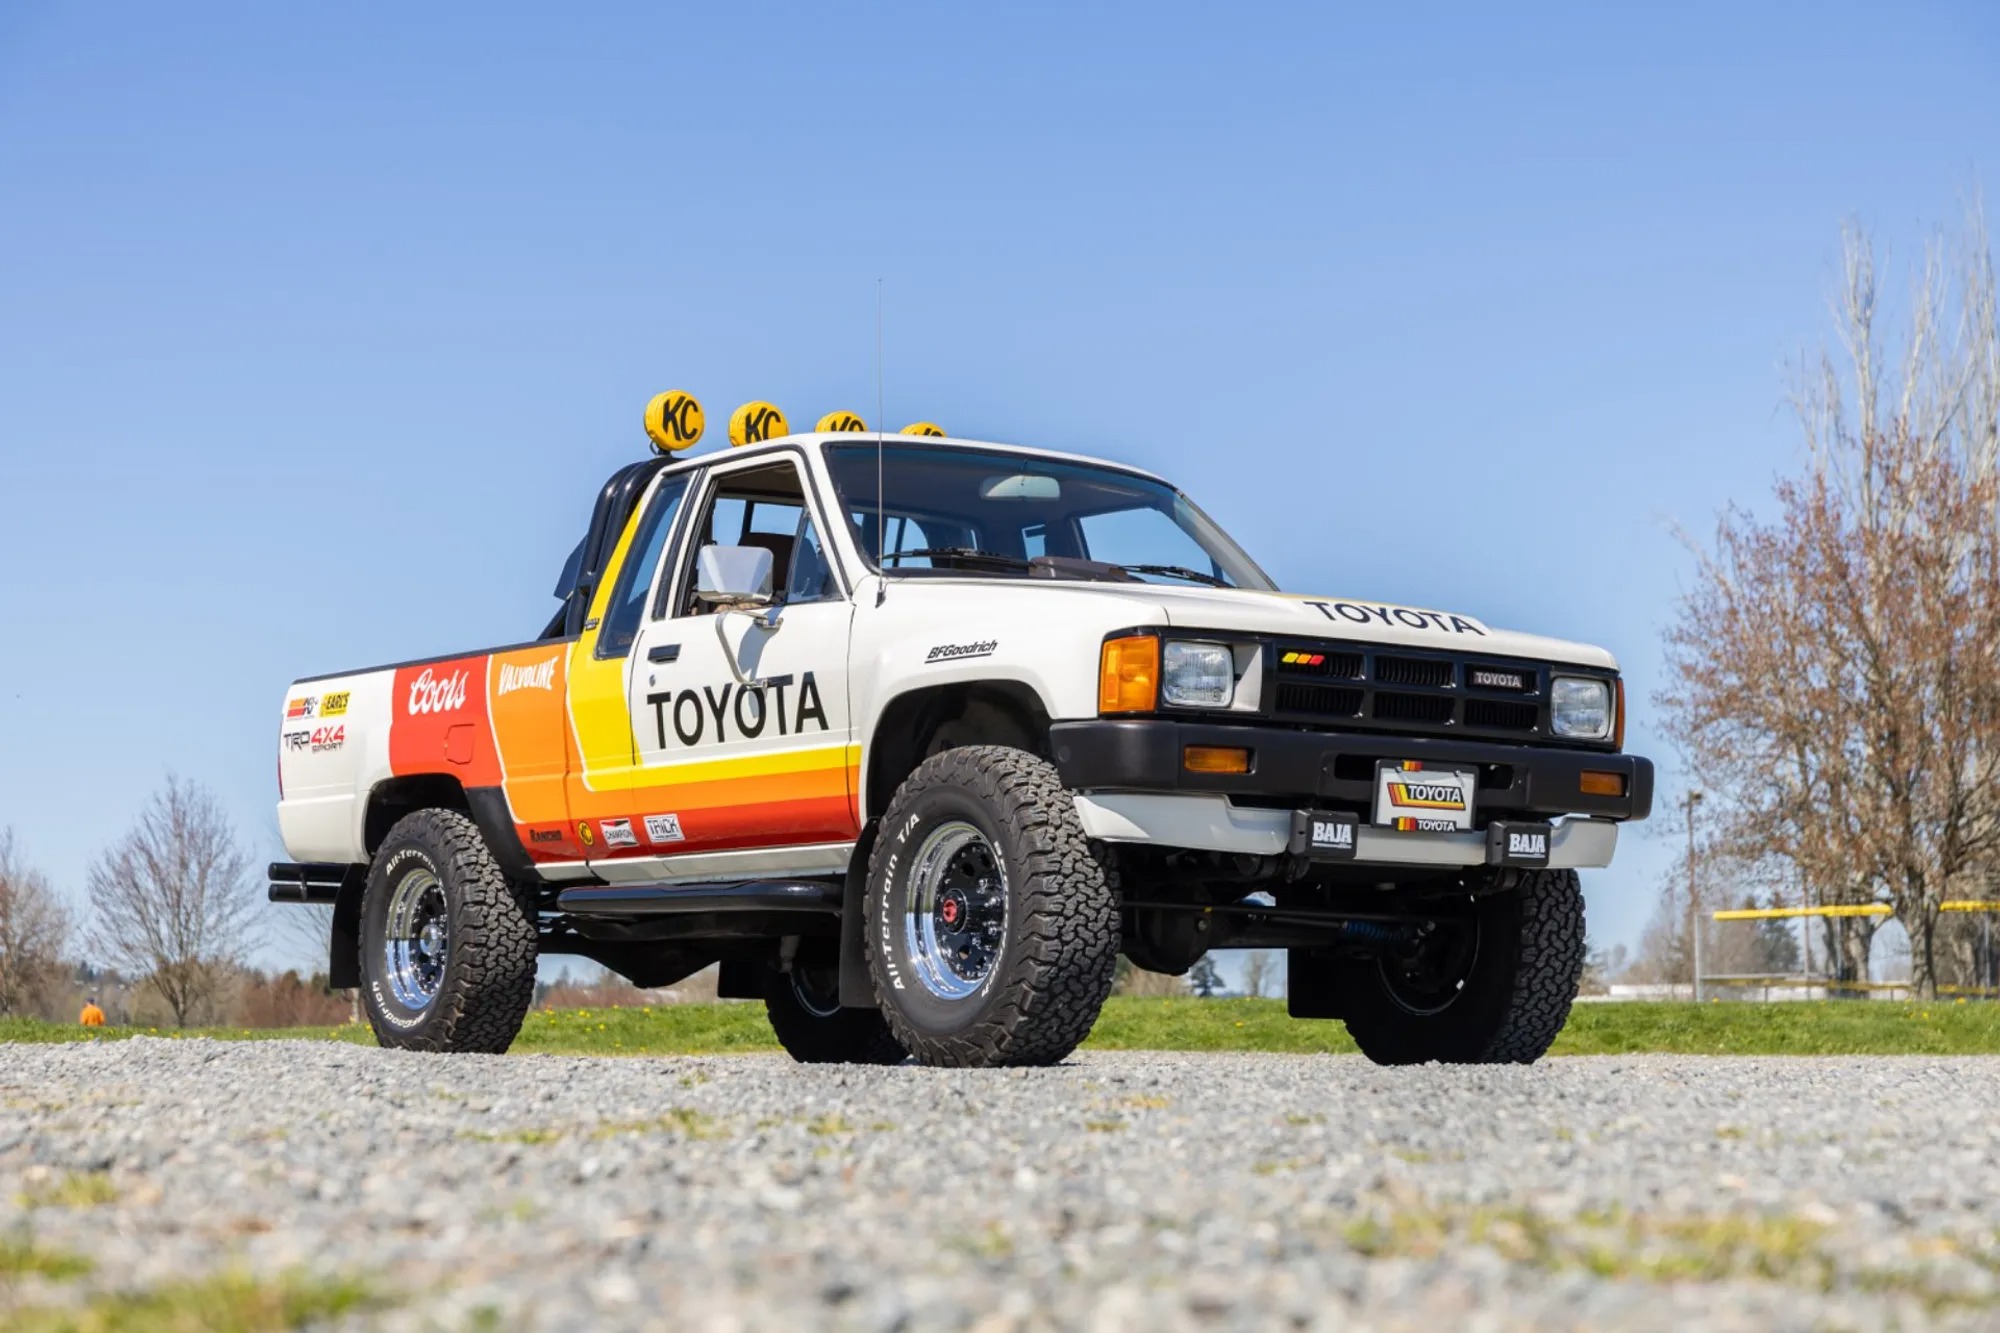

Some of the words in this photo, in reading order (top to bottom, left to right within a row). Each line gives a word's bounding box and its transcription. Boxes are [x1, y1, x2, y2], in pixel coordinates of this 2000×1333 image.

[662, 396, 699, 441] KC
[1303, 600, 1486, 636] TOYOTA
[927, 639, 998, 659] BFGoodrich
[498, 656, 560, 696] VALVOLINE
[1475, 672, 1522, 688] TOYOTA
[408, 668, 470, 716] Coors
[646, 671, 829, 750] TOYOTA
[284, 730, 310, 752] TRD
[1408, 785, 1463, 802] TOYOTA
[1312, 821, 1352, 843] BAJA
[1417, 820, 1456, 832] TOYOTA
[1509, 833, 1546, 853] BAJA
[386, 849, 437, 877] All-Terrain
[881, 853, 905, 990] All-Terrain
[897, 812, 920, 844] T/A
